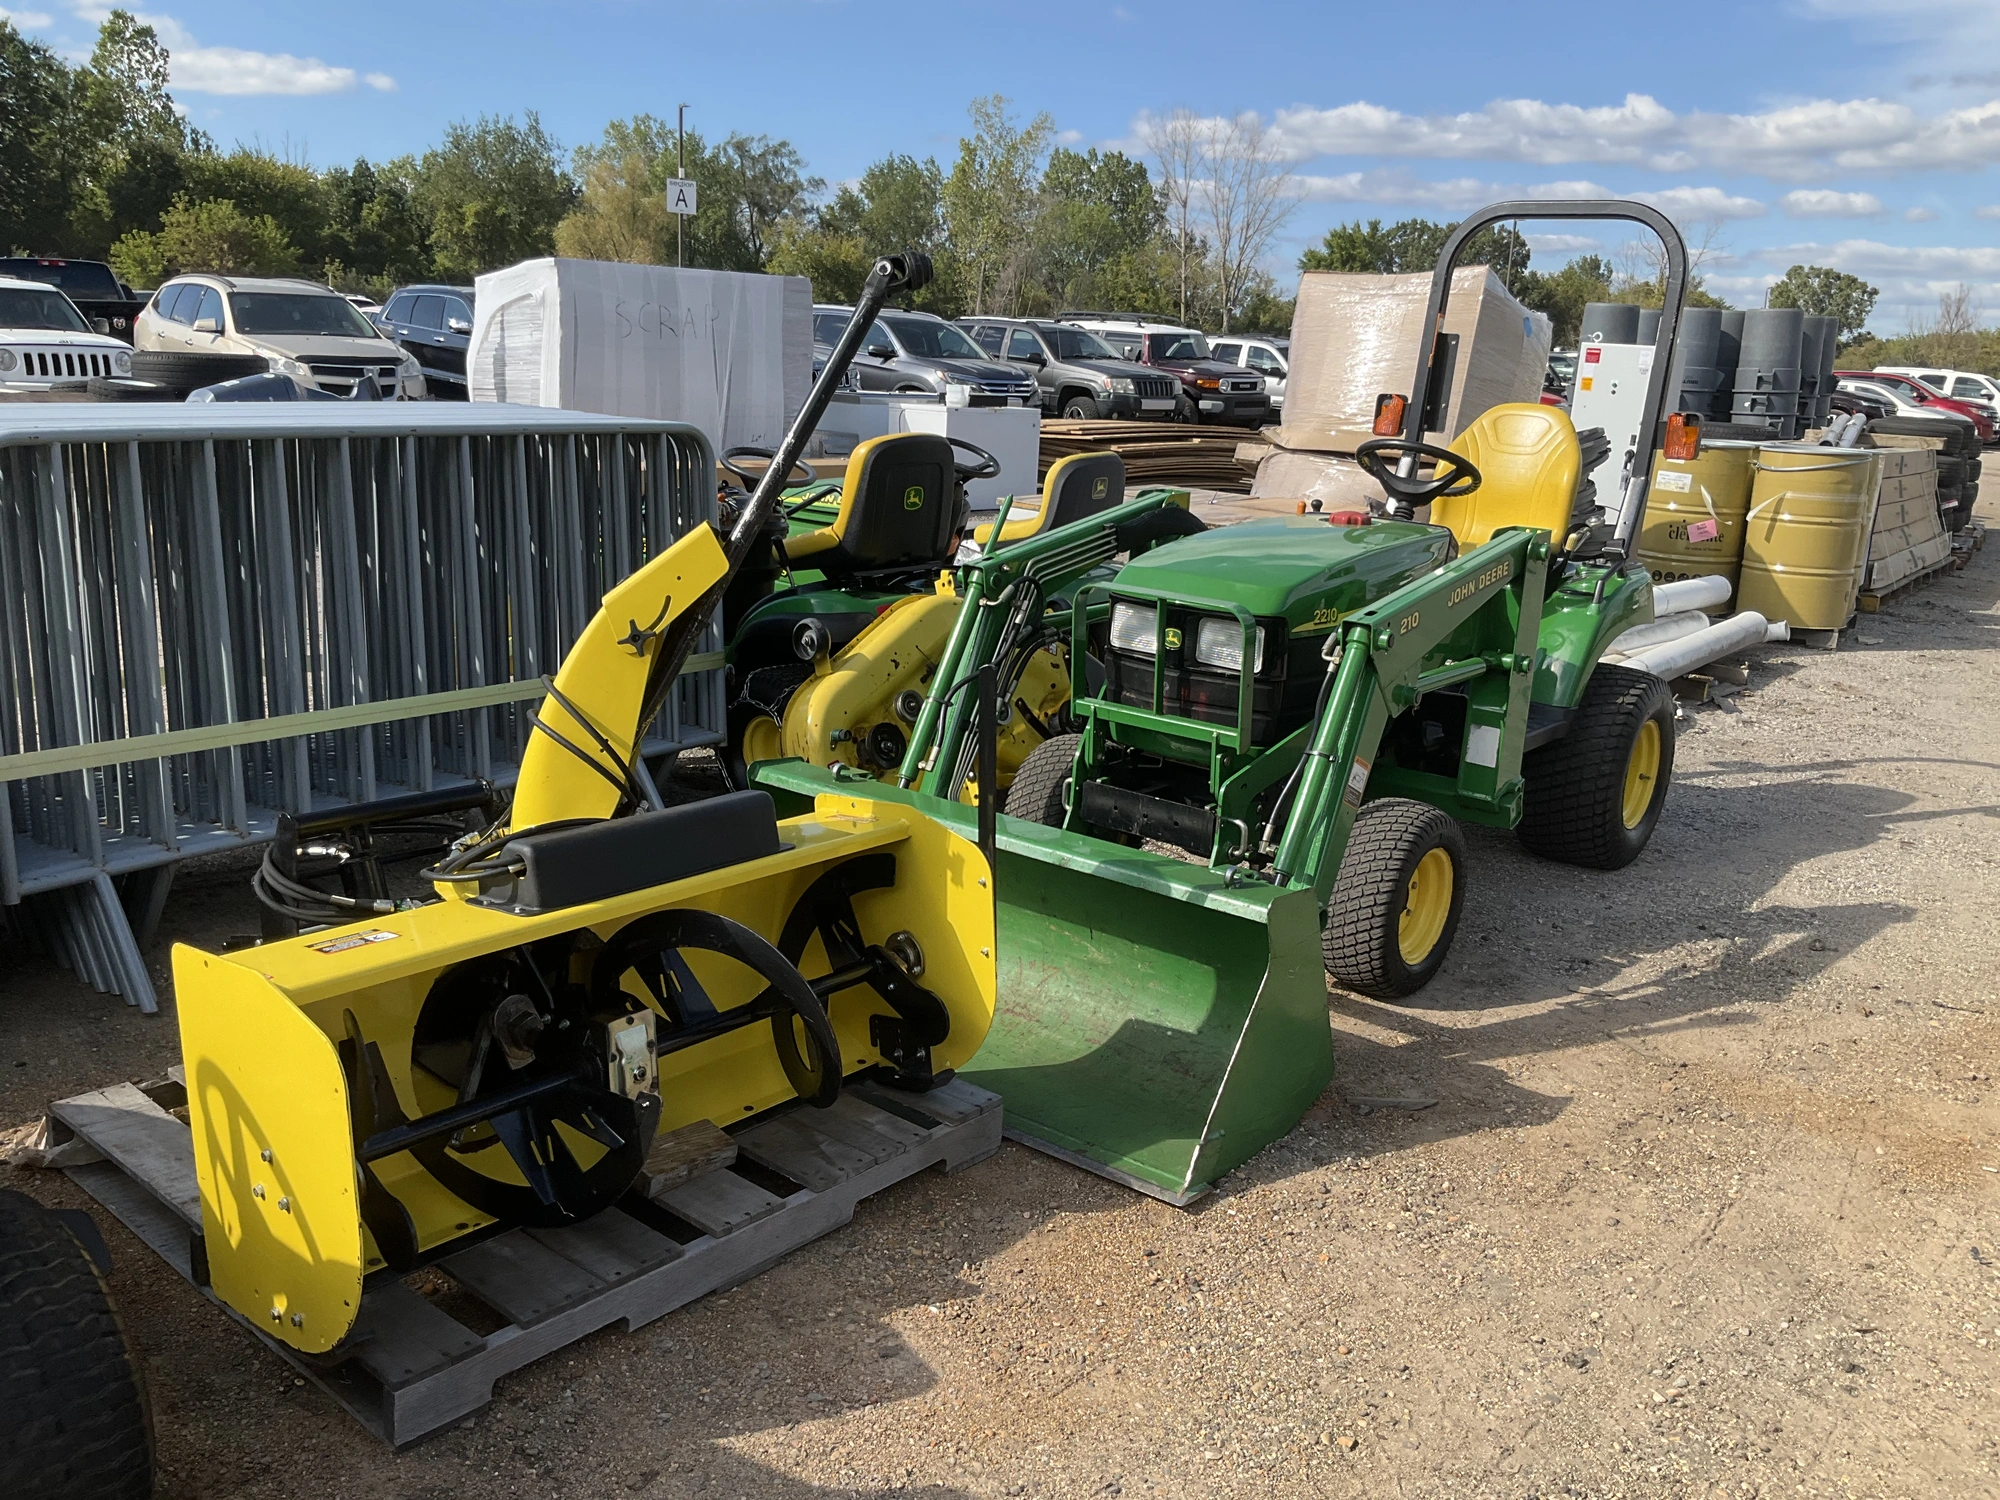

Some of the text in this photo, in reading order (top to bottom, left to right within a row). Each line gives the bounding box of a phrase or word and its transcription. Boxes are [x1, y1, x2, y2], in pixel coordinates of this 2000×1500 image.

[669, 180, 695, 188] section
[675, 188, 688, 208] A
[615, 301, 719, 340] SCRAP
[1668, 526, 1724, 543] clete
[1447, 561, 1509, 607] JOHN DEERE
[1313, 607, 1338, 624] 2210
[1400, 611, 1420, 635] 210
